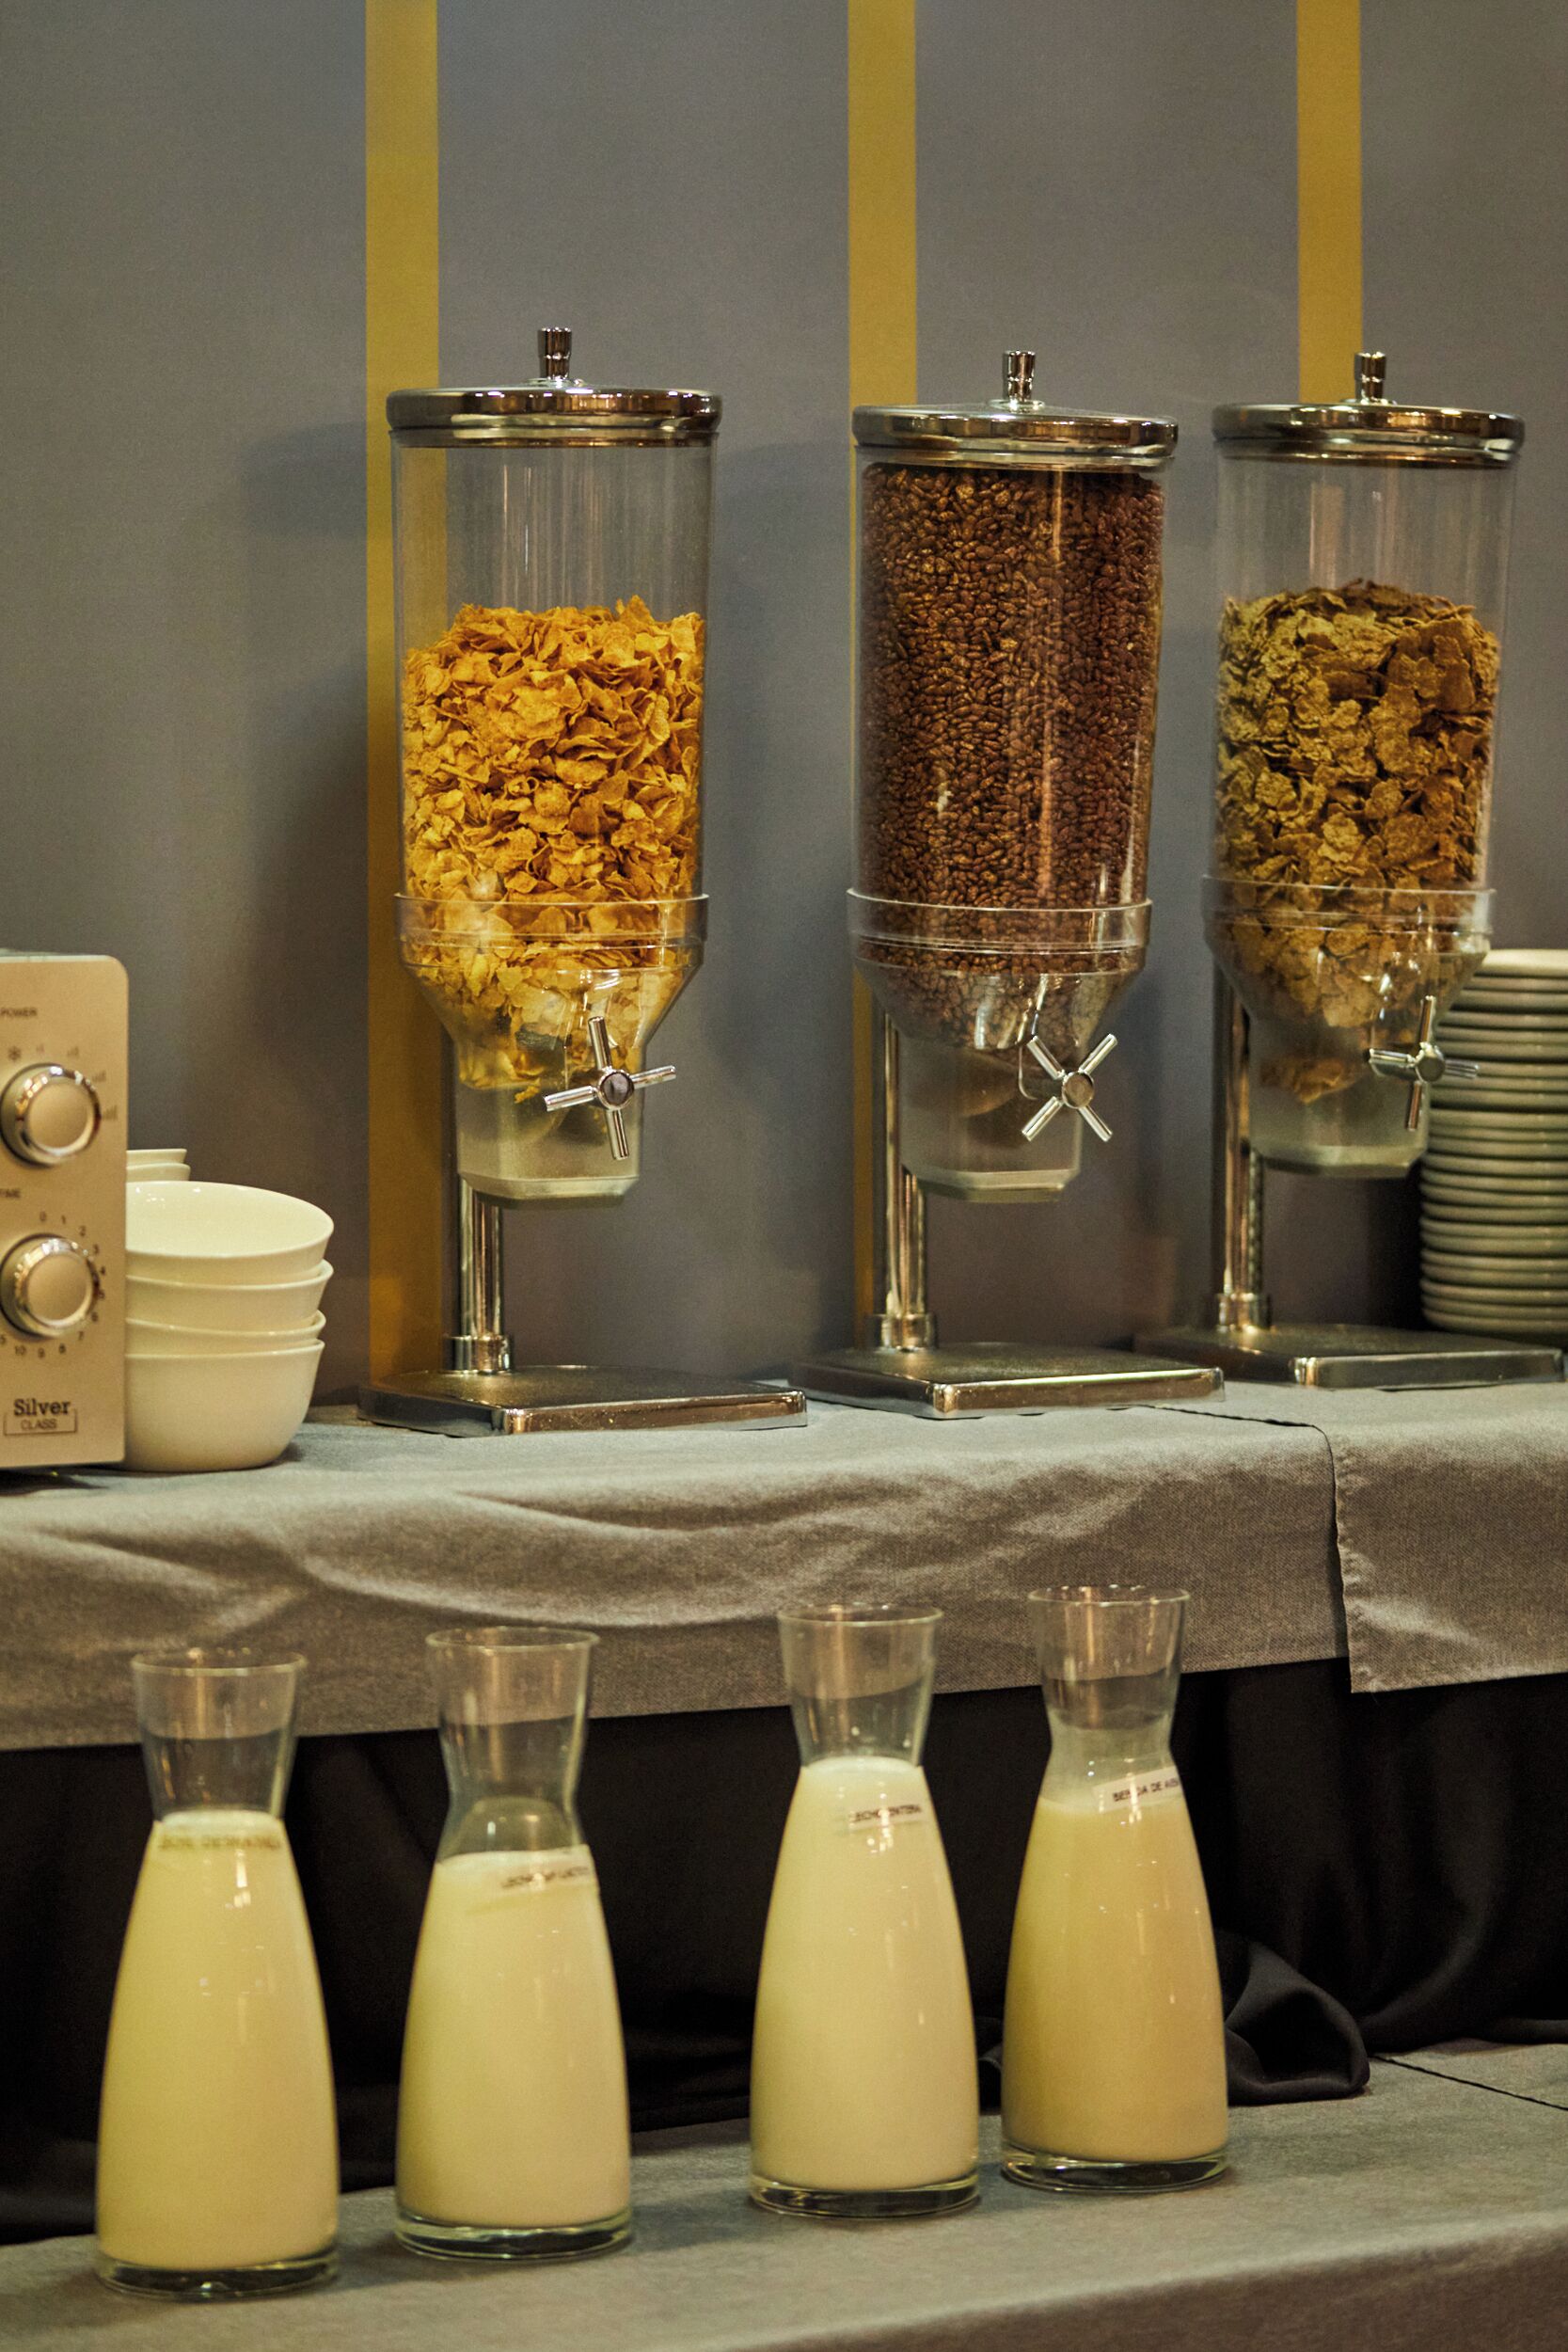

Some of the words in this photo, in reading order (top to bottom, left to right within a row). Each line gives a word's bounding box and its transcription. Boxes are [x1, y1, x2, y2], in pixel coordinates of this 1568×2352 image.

[15, 1345, 26, 1356] 10
[14, 1398, 71, 1416] Silver
[21, 1419, 57, 1430] CLASS
